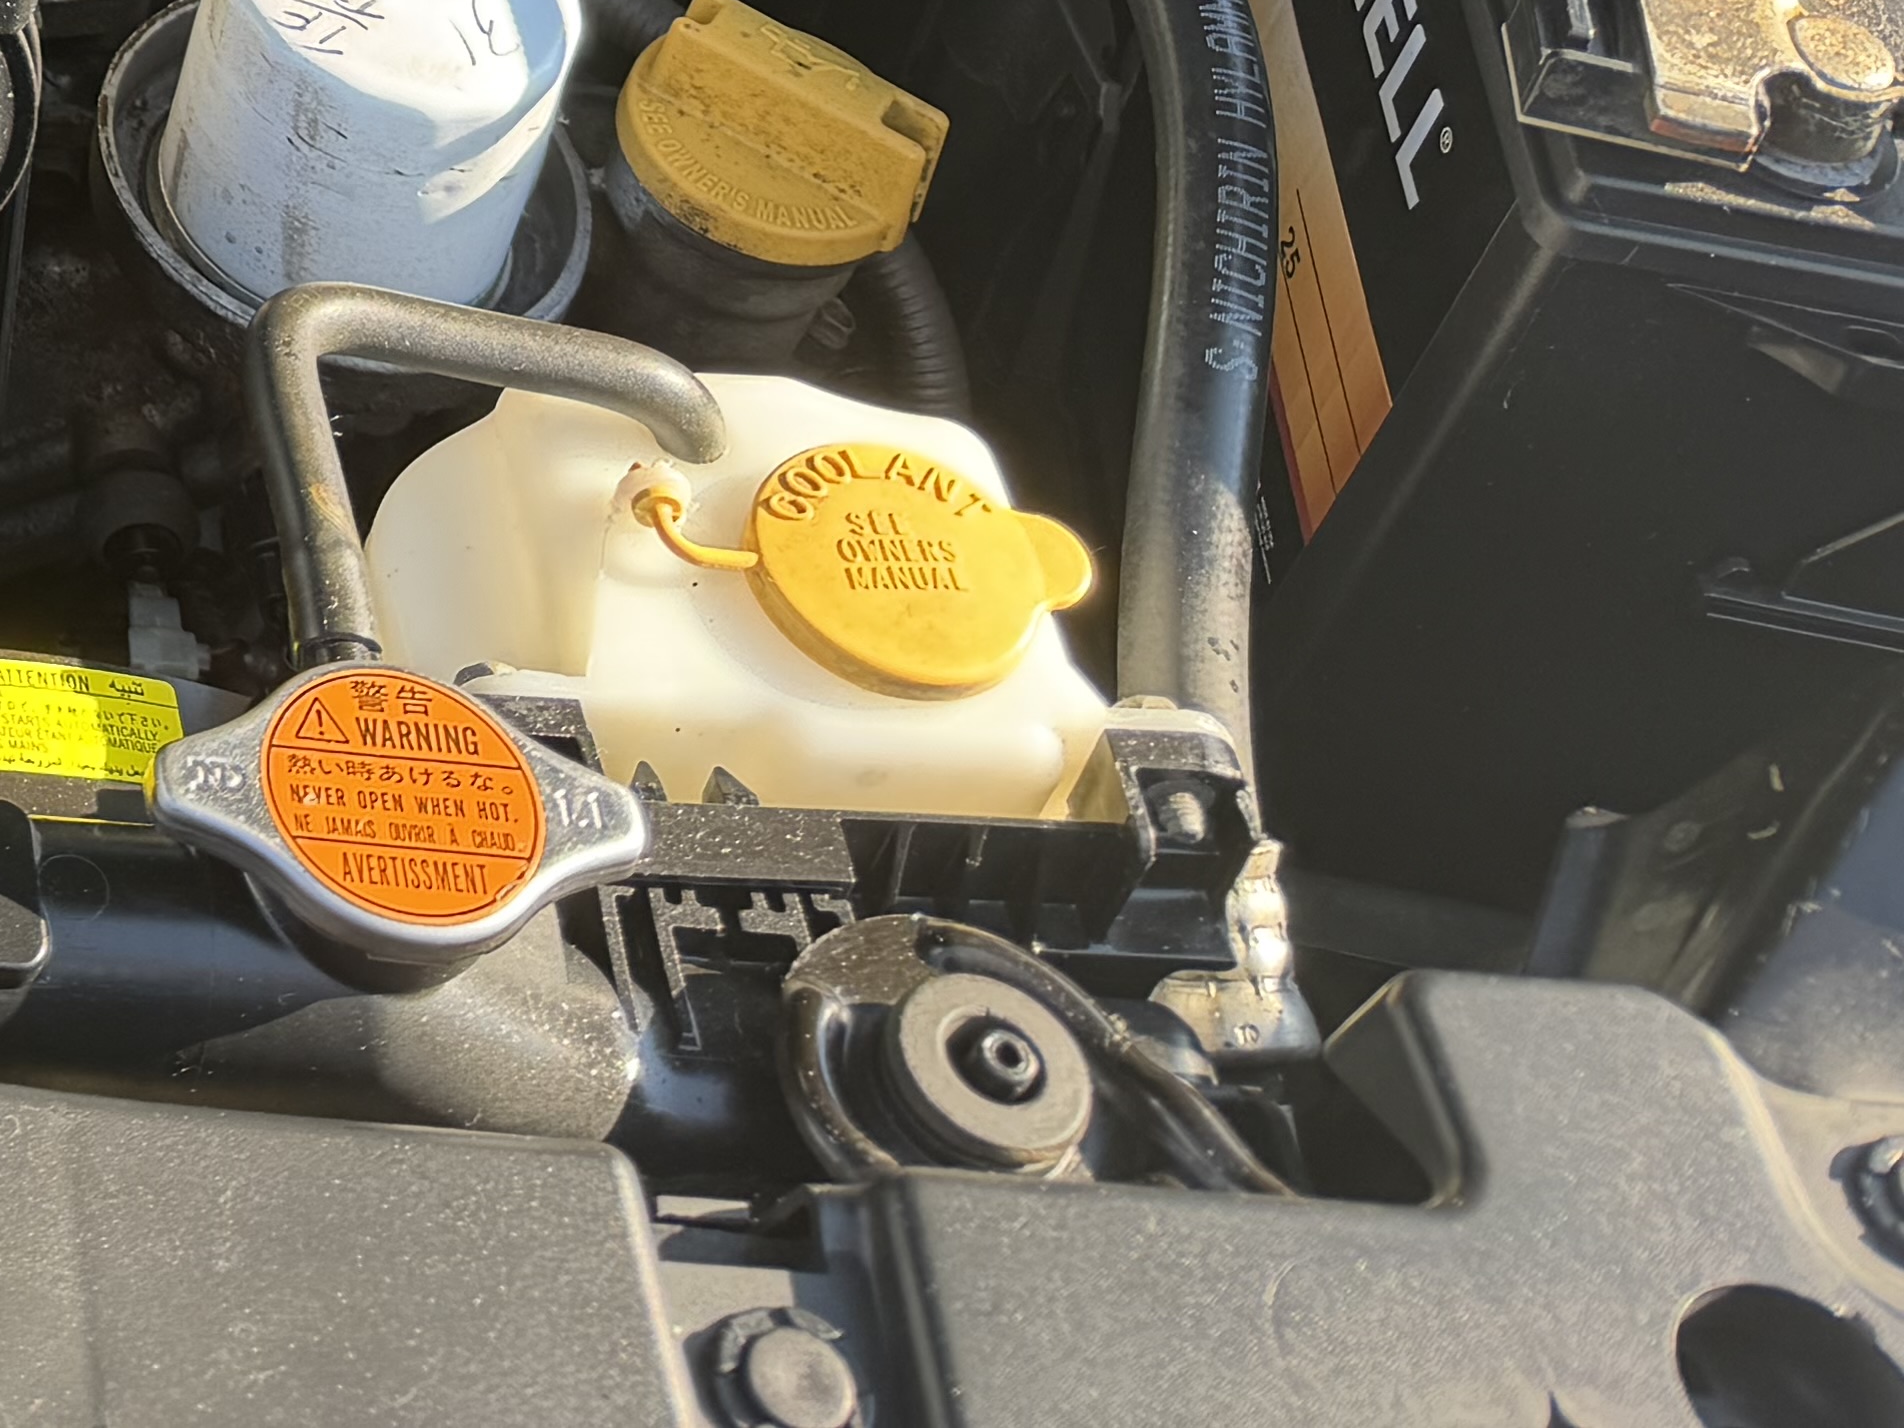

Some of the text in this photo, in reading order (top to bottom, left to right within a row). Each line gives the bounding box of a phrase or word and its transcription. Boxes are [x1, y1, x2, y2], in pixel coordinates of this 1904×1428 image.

[640, 99, 860, 230] SEE OWNER'S MANUAL
[758, 449, 993, 521] COOLANT
[844, 509, 908, 536] SEE
[843, 566, 968, 592] MANUAL
[349, 679, 433, 718] 警告
[354, 716, 481, 757] WARNING
[291, 783, 347, 808] NEVER
[357, 791, 405, 814] OPEN
[415, 795, 466, 820] WHEN
[293, 813, 316, 834] NE
[325, 815, 378, 840] JAMAIS
[389, 822, 435, 847] OUVRIR
[342, 851, 490, 896] AVERTISSMENT
